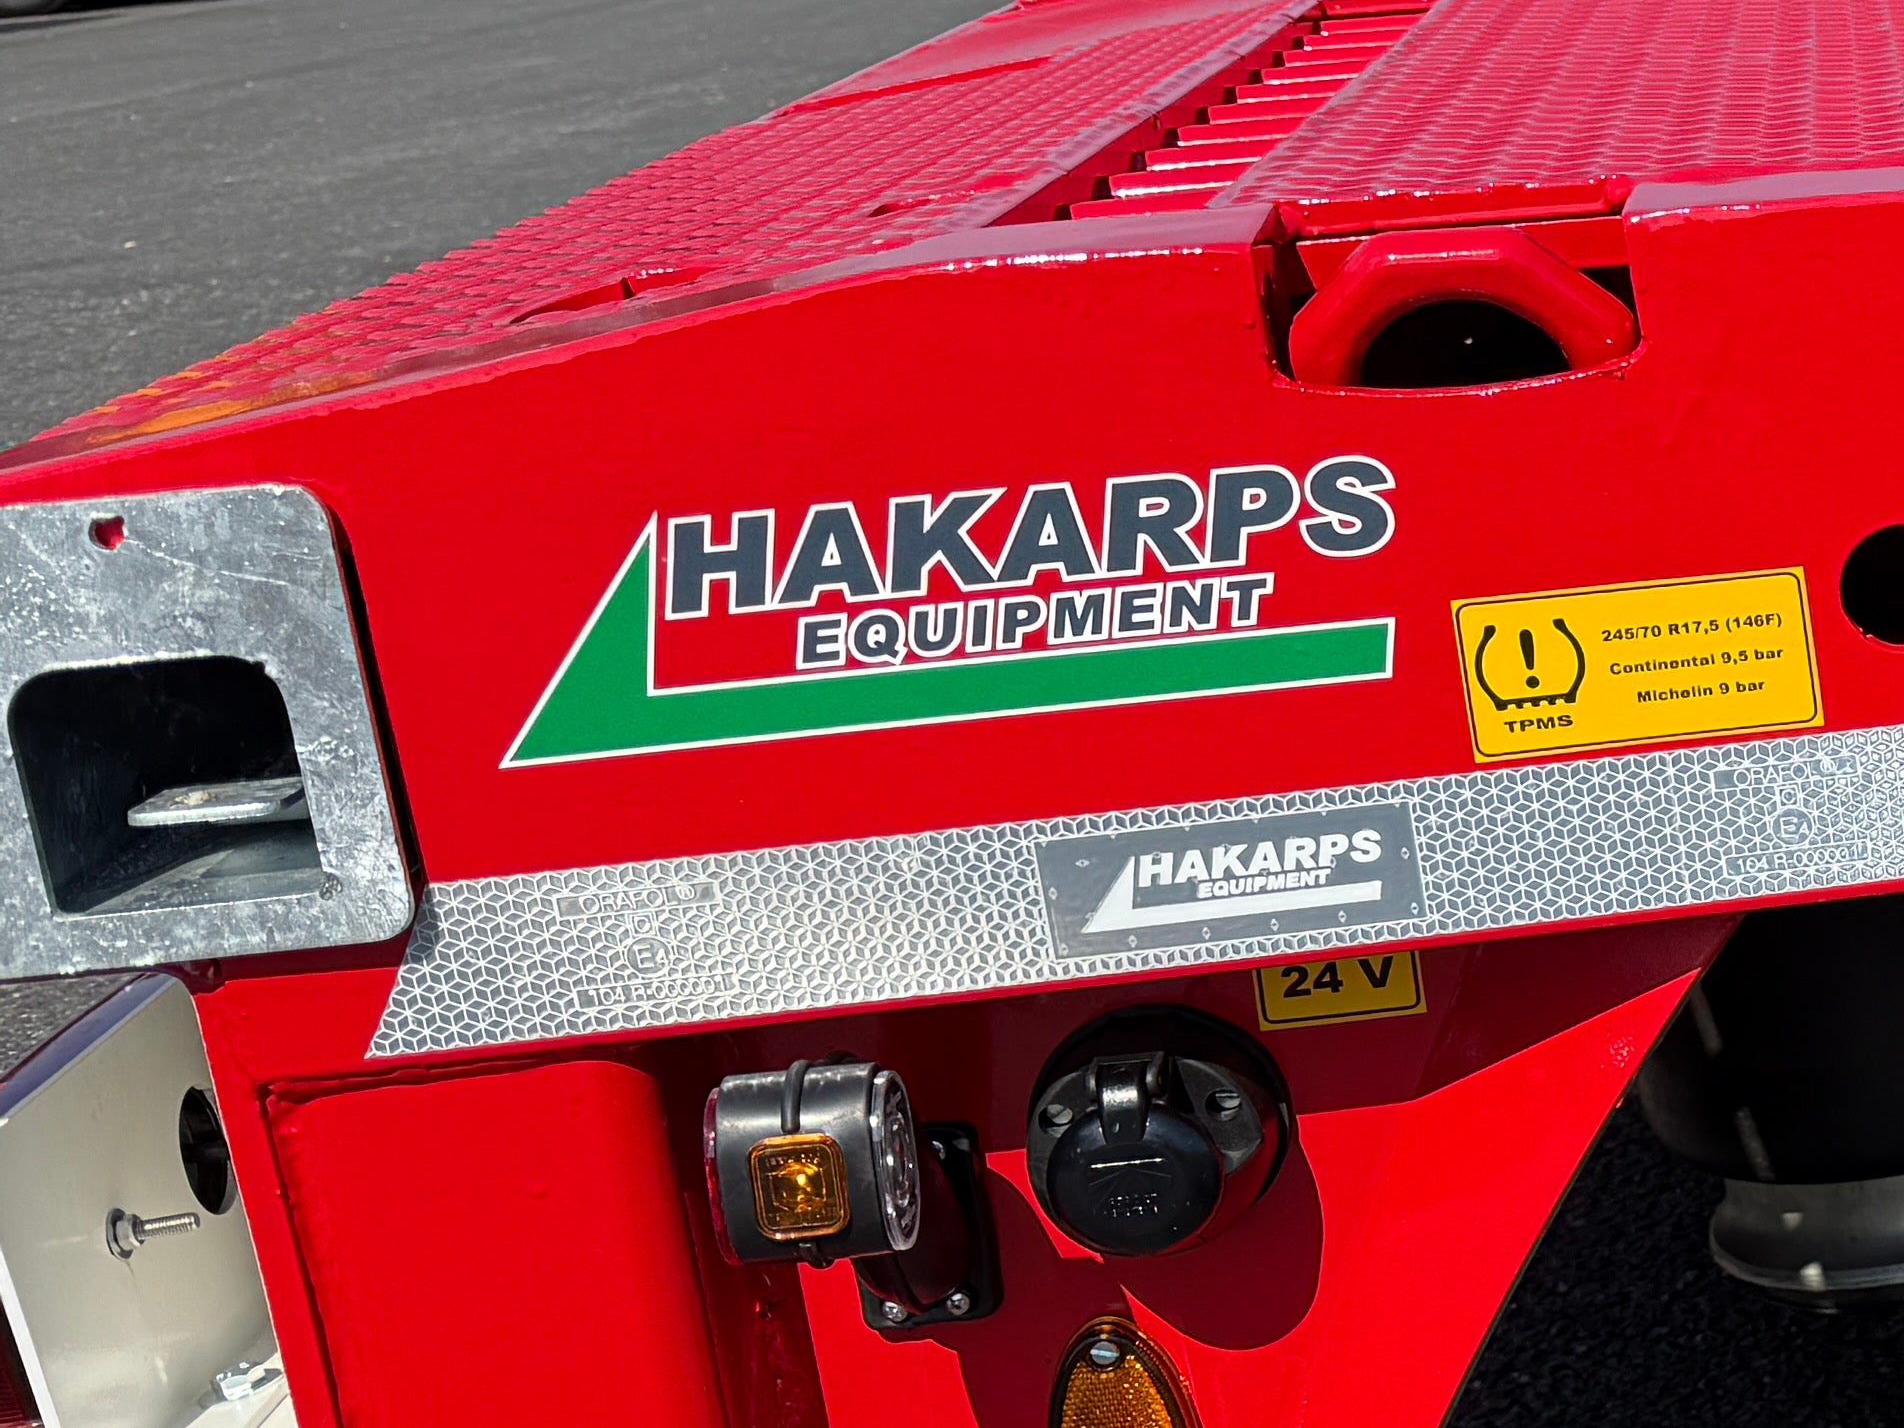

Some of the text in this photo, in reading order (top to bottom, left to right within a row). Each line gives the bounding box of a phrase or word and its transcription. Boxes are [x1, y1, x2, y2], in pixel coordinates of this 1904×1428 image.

[665, 453, 1396, 621] HAKARPS
[797, 572, 1275, 670] EQUIPMENT
[1601, 613, 1783, 643] 245/70 R17,5 (146F)
[1609, 646, 1784, 676] Continental 9,5 bar
[1637, 678, 1766, 704] Michelin 9 bar
[1503, 713, 1574, 734] TPMS
[1138, 827, 1383, 889] HAKARPS
[1197, 868, 1333, 901] EQUIPMENT
[1280, 955, 1396, 999] 24 V
